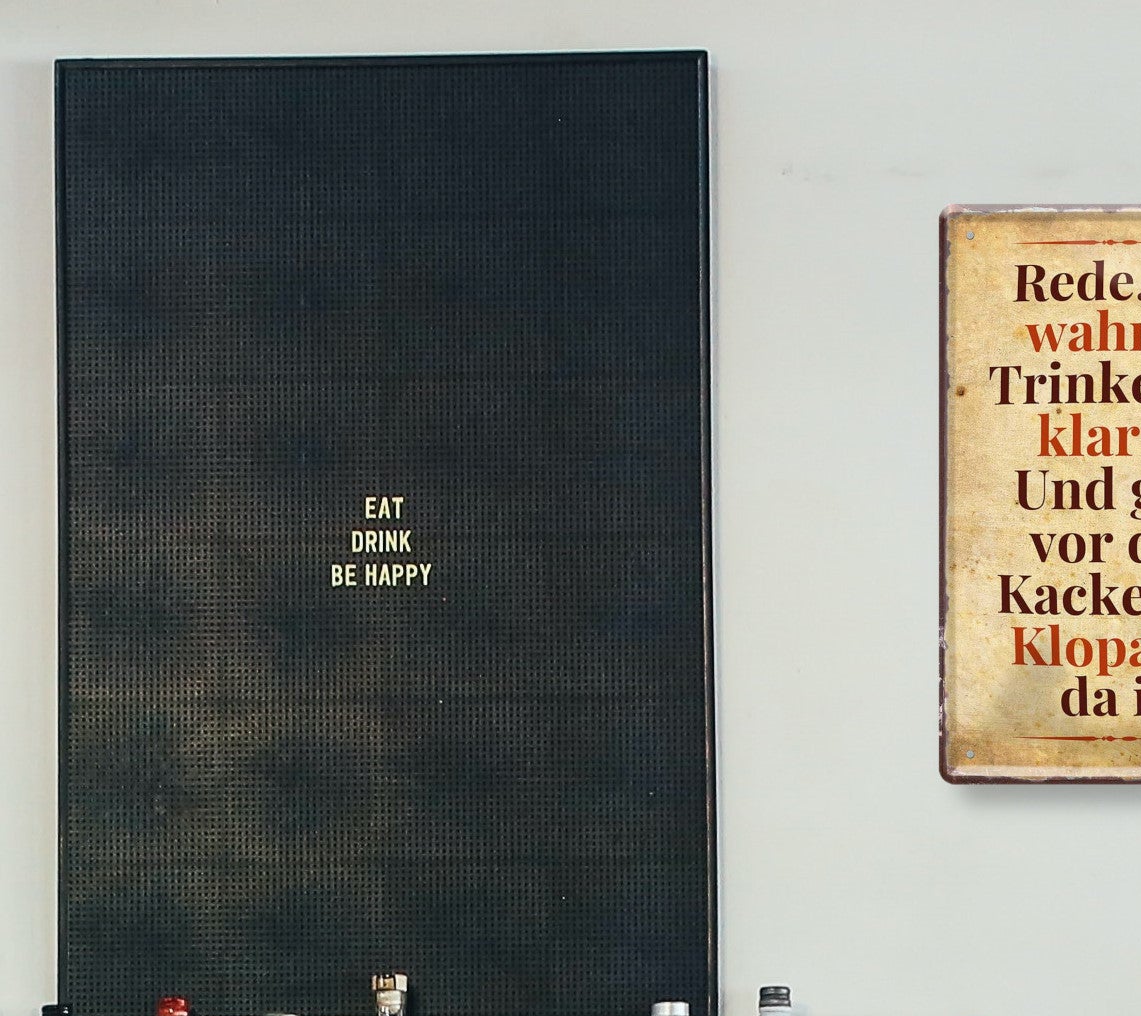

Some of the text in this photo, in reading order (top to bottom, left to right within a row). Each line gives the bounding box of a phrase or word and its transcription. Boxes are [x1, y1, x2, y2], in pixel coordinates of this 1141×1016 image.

[1037, 412, 1140, 457] klar
[1015, 465, 1117, 511] Und
[365, 496, 404, 520] EAT
[351, 529, 412, 553] DRINK
[1028, 532, 1114, 564] vor
[331, 563, 432, 587] BE HAPPY
[1060, 675, 1120, 717] da
